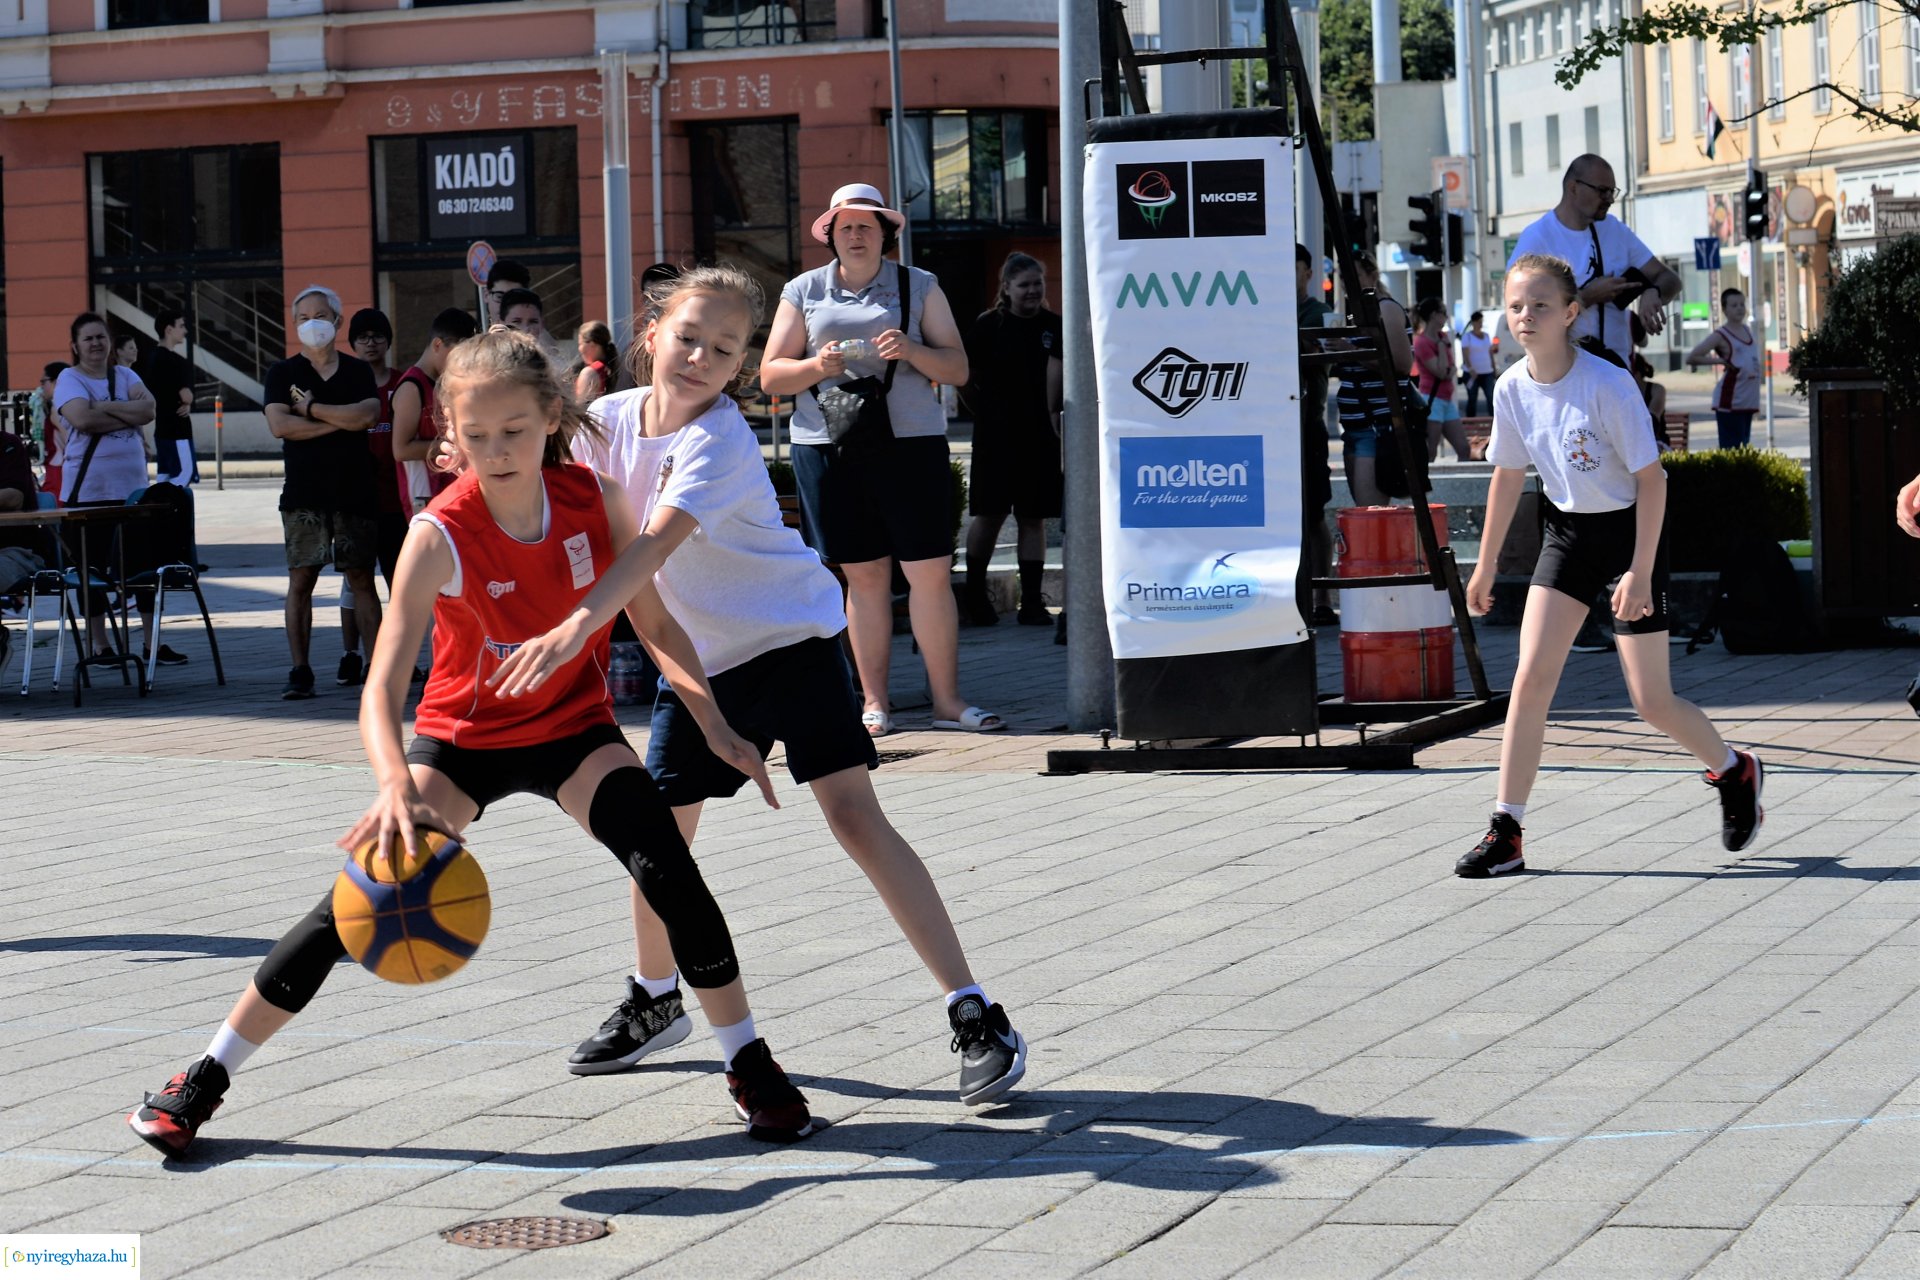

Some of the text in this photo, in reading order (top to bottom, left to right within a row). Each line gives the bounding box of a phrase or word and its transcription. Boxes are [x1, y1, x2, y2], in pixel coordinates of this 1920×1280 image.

[435, 146, 515, 190] KIADÓ
[1201, 192, 1257, 203] MKOSZ
[1116, 270, 1258, 308] MVM
[1158, 362, 1249, 401] TOTI
[1137, 460, 1248, 487] molten
[1133, 490, 1248, 508] For the real game
[1127, 583, 1250, 601] Primavera
